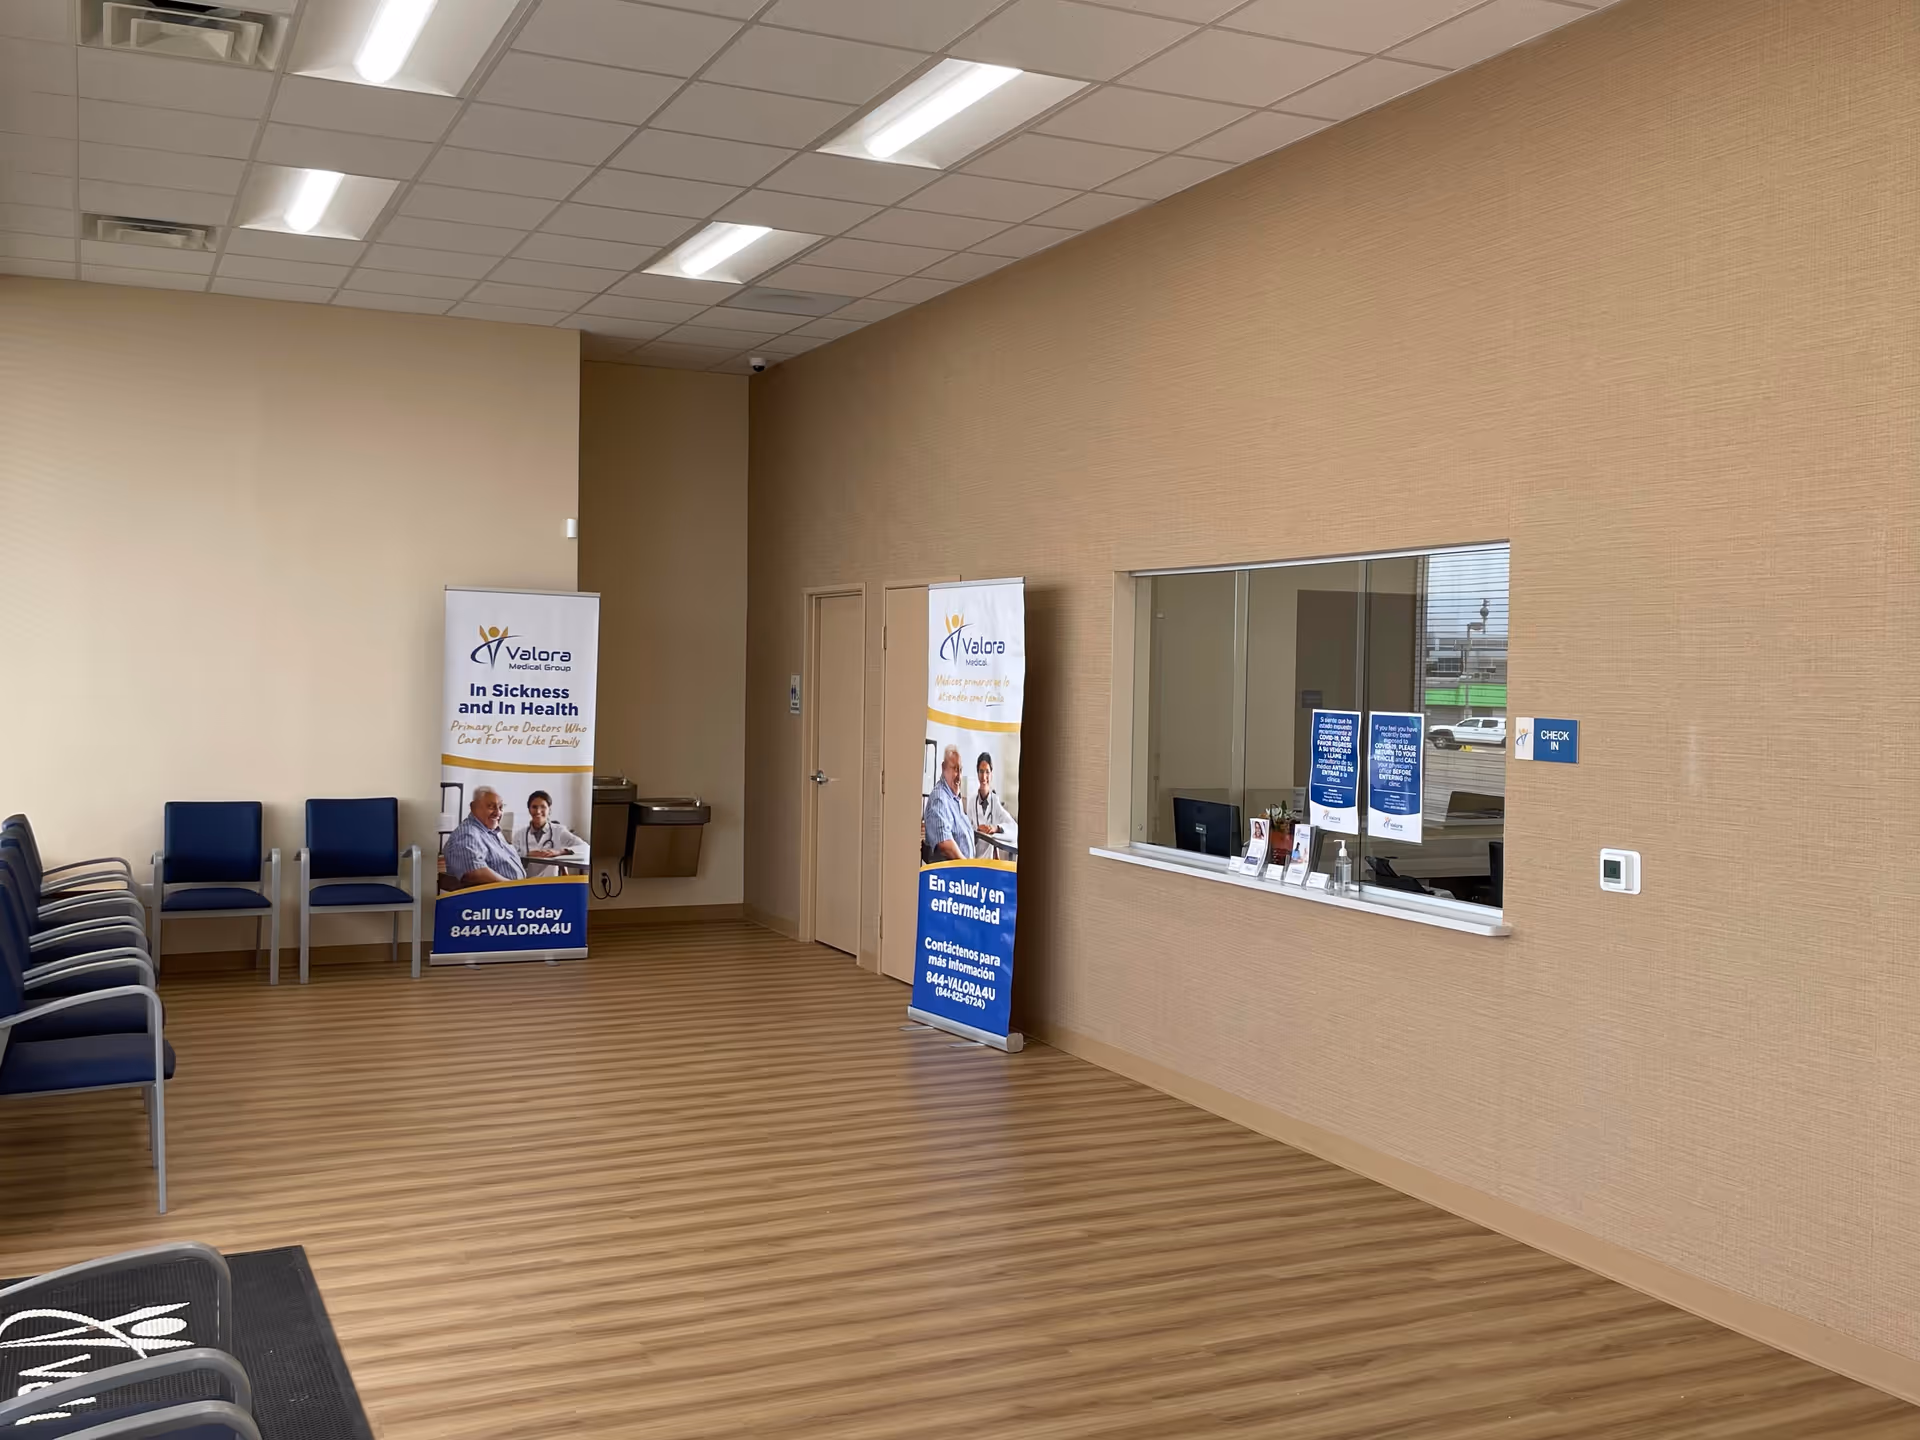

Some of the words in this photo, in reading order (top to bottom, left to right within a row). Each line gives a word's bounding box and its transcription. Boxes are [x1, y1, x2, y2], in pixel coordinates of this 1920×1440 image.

[962, 636, 1005, 654] Valora
[506, 646, 571, 662] Valora
[508, 663, 542, 671] Medical
[544, 664, 571, 672] Group
[966, 658, 987, 666] Medical
[470, 683, 486, 696] In
[492, 684, 569, 699] Sickness
[458, 701, 492, 714] and
[499, 702, 515, 714] In
[521, 702, 578, 716] Health
[451, 720, 492, 734] Primary
[495, 721, 519, 732] Care
[522, 722, 561, 733] Doctors
[565, 723, 587, 733] Who
[458, 734, 482, 744] Care
[486, 734, 503, 744] For
[507, 735, 522, 745] You
[526, 735, 545, 745] Like
[550, 735, 580, 747] Family
[1541, 730, 1569, 740] CHECK
[1551, 741, 1558, 750] IN
[929, 874, 945, 892] En
[948, 879, 979, 898] salud
[980, 887, 987, 903] y
[989, 889, 1005, 904] en
[461, 908, 490, 921] Call
[494, 908, 513, 920] Us
[517, 907, 562, 920] Today
[931, 897, 1000, 925] enfermedad
[451, 922, 571, 937] 844-VALORA4U
[925, 937, 979, 961] Contáctenos
[980, 952, 1000, 967] para
[928, 954, 947, 968] más
[948, 957, 995, 981] información
[926, 971, 995, 1001] 844-VALORA4U
[935, 986, 986, 1010] (844-825-6724)
